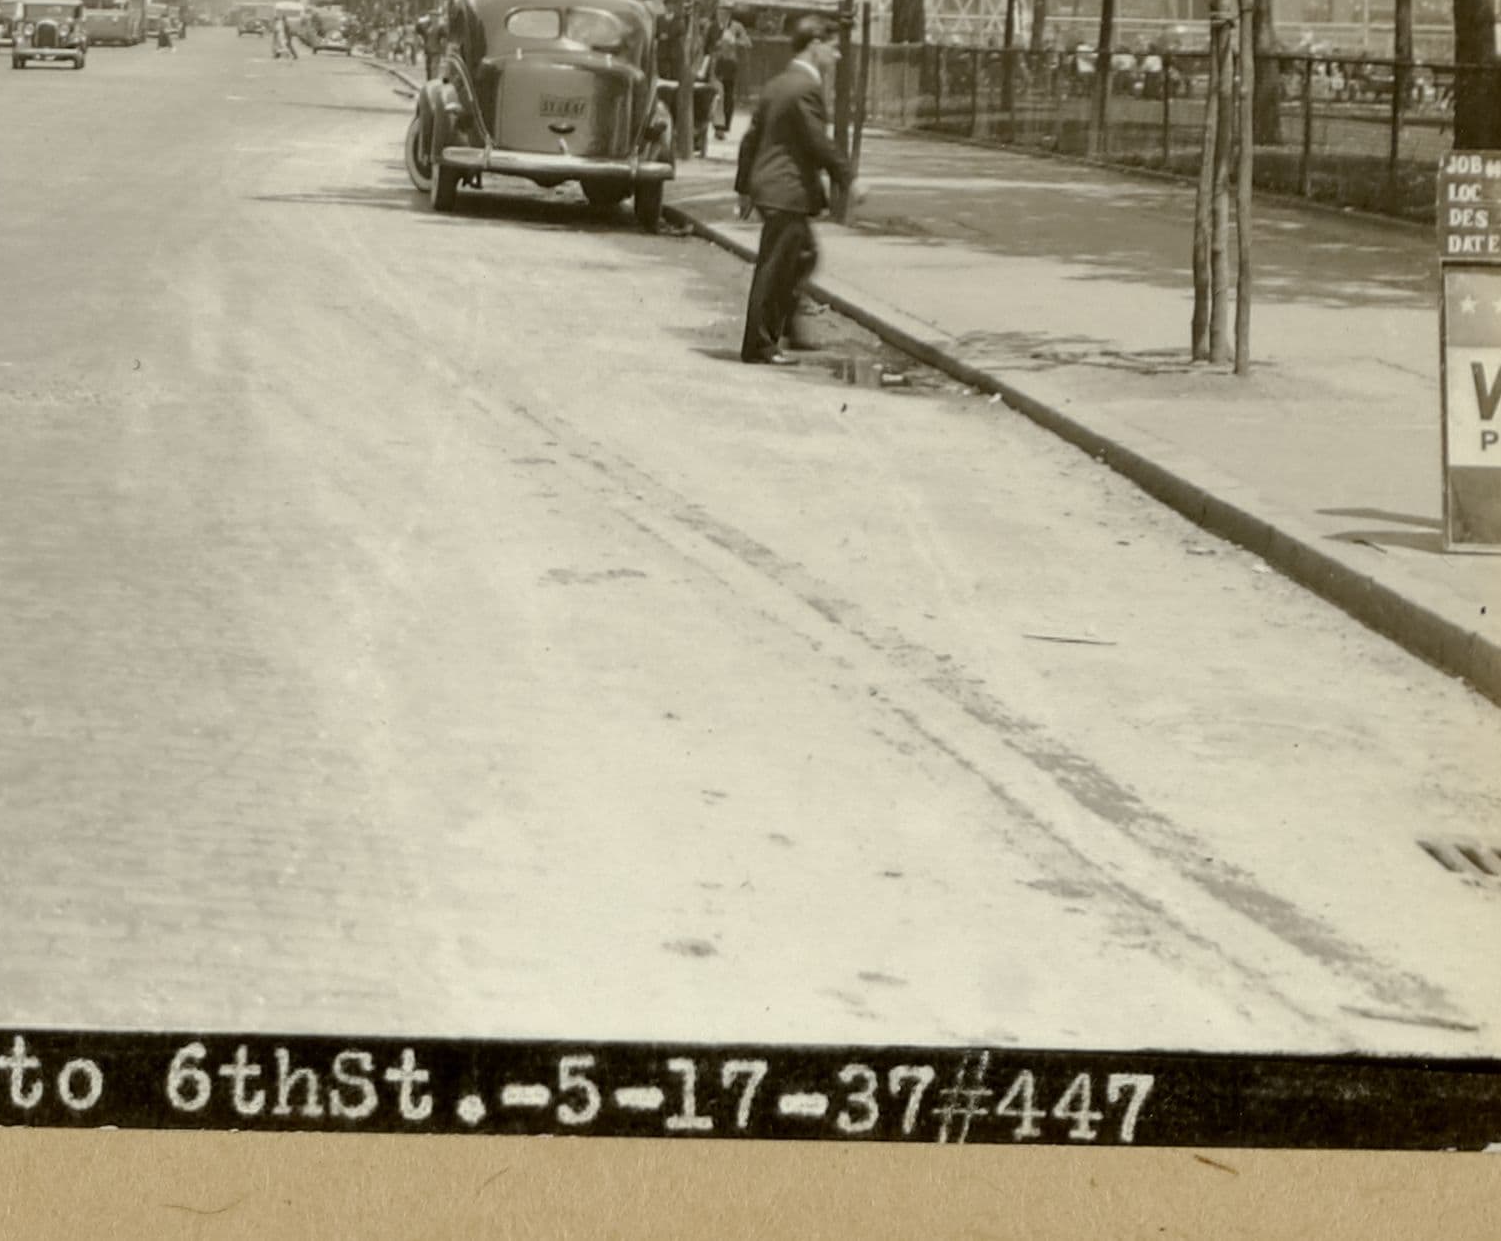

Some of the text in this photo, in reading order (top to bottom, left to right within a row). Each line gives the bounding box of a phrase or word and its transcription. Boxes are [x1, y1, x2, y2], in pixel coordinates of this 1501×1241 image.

[1446, 155, 1482, 174] JOB
[1448, 183, 1481, 202] LOC
[1449, 208, 1488, 229] DES
[1448, 234, 1499, 254] DATE
